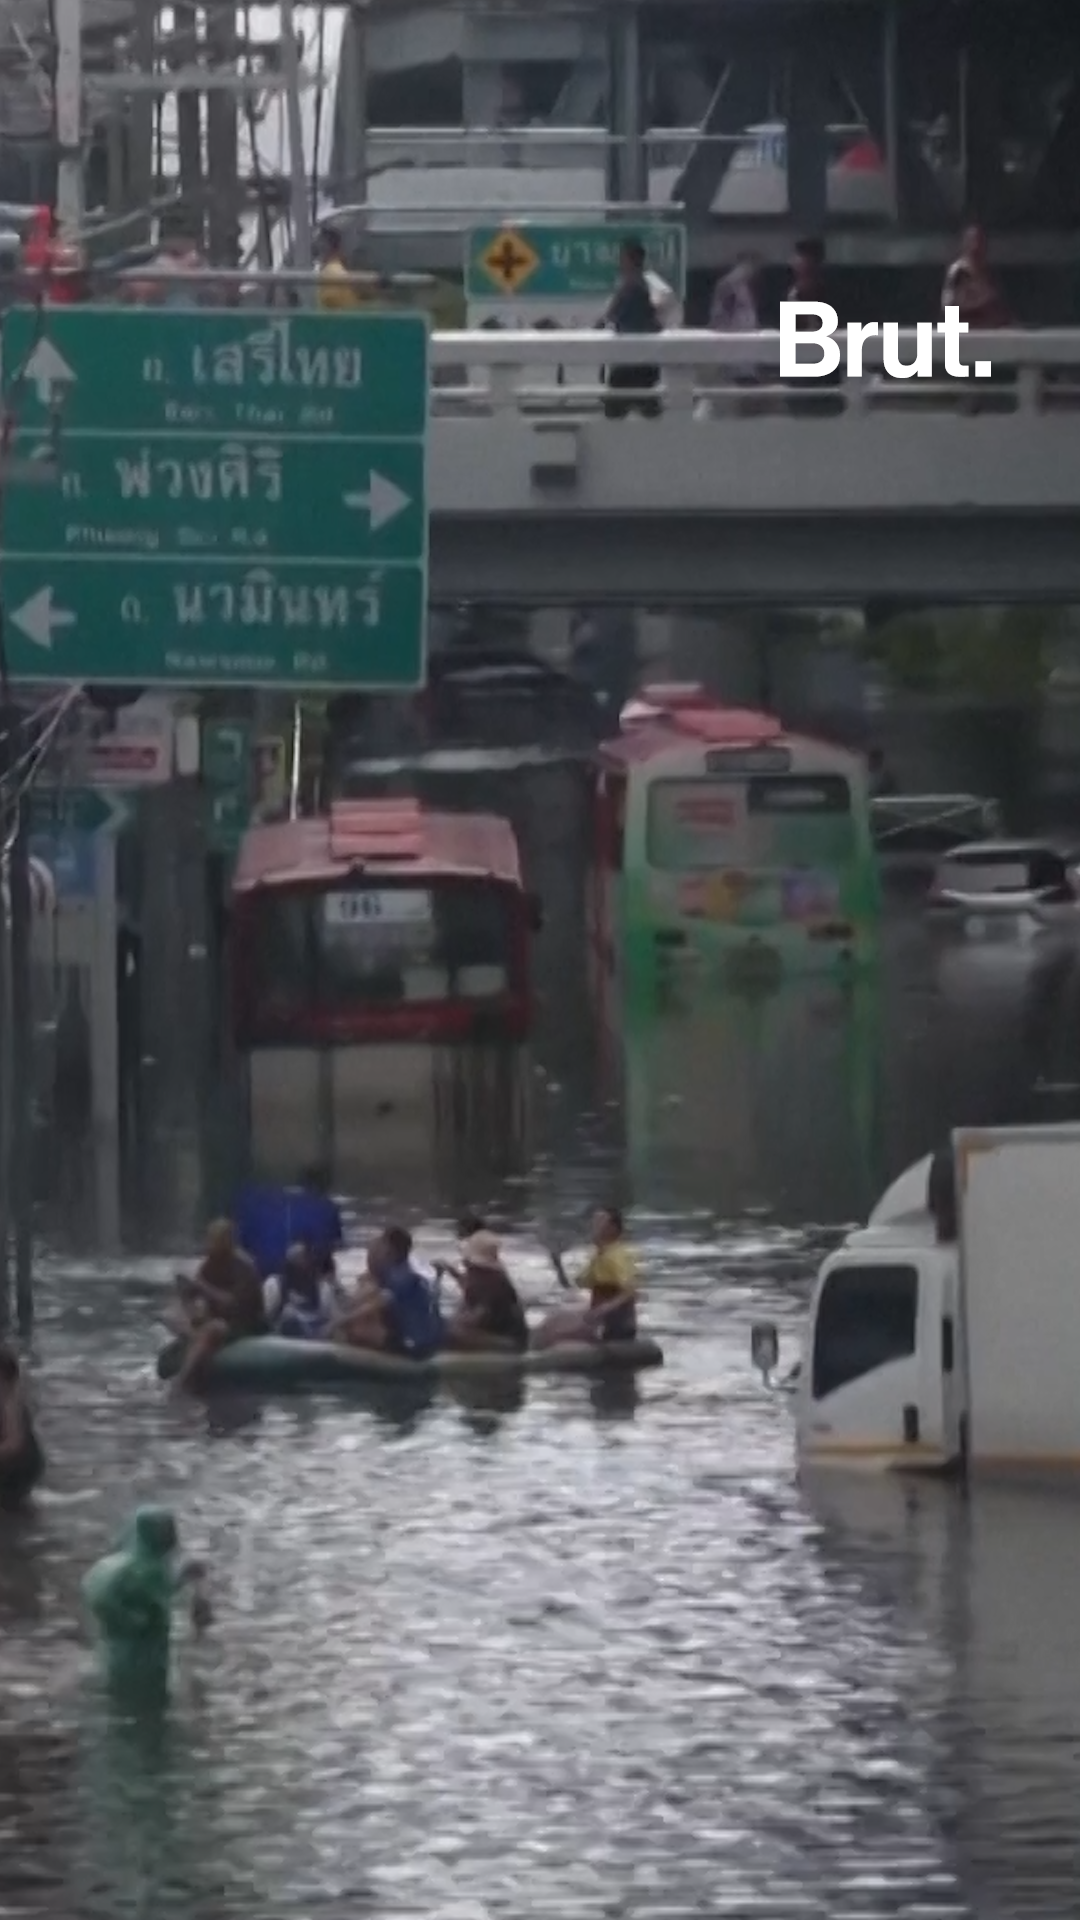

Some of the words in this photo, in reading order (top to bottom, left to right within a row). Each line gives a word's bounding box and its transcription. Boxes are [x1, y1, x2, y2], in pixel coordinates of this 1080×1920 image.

[192, 317, 363, 388] เสรีไทย
[173, 566, 387, 628] นวมินทร์
